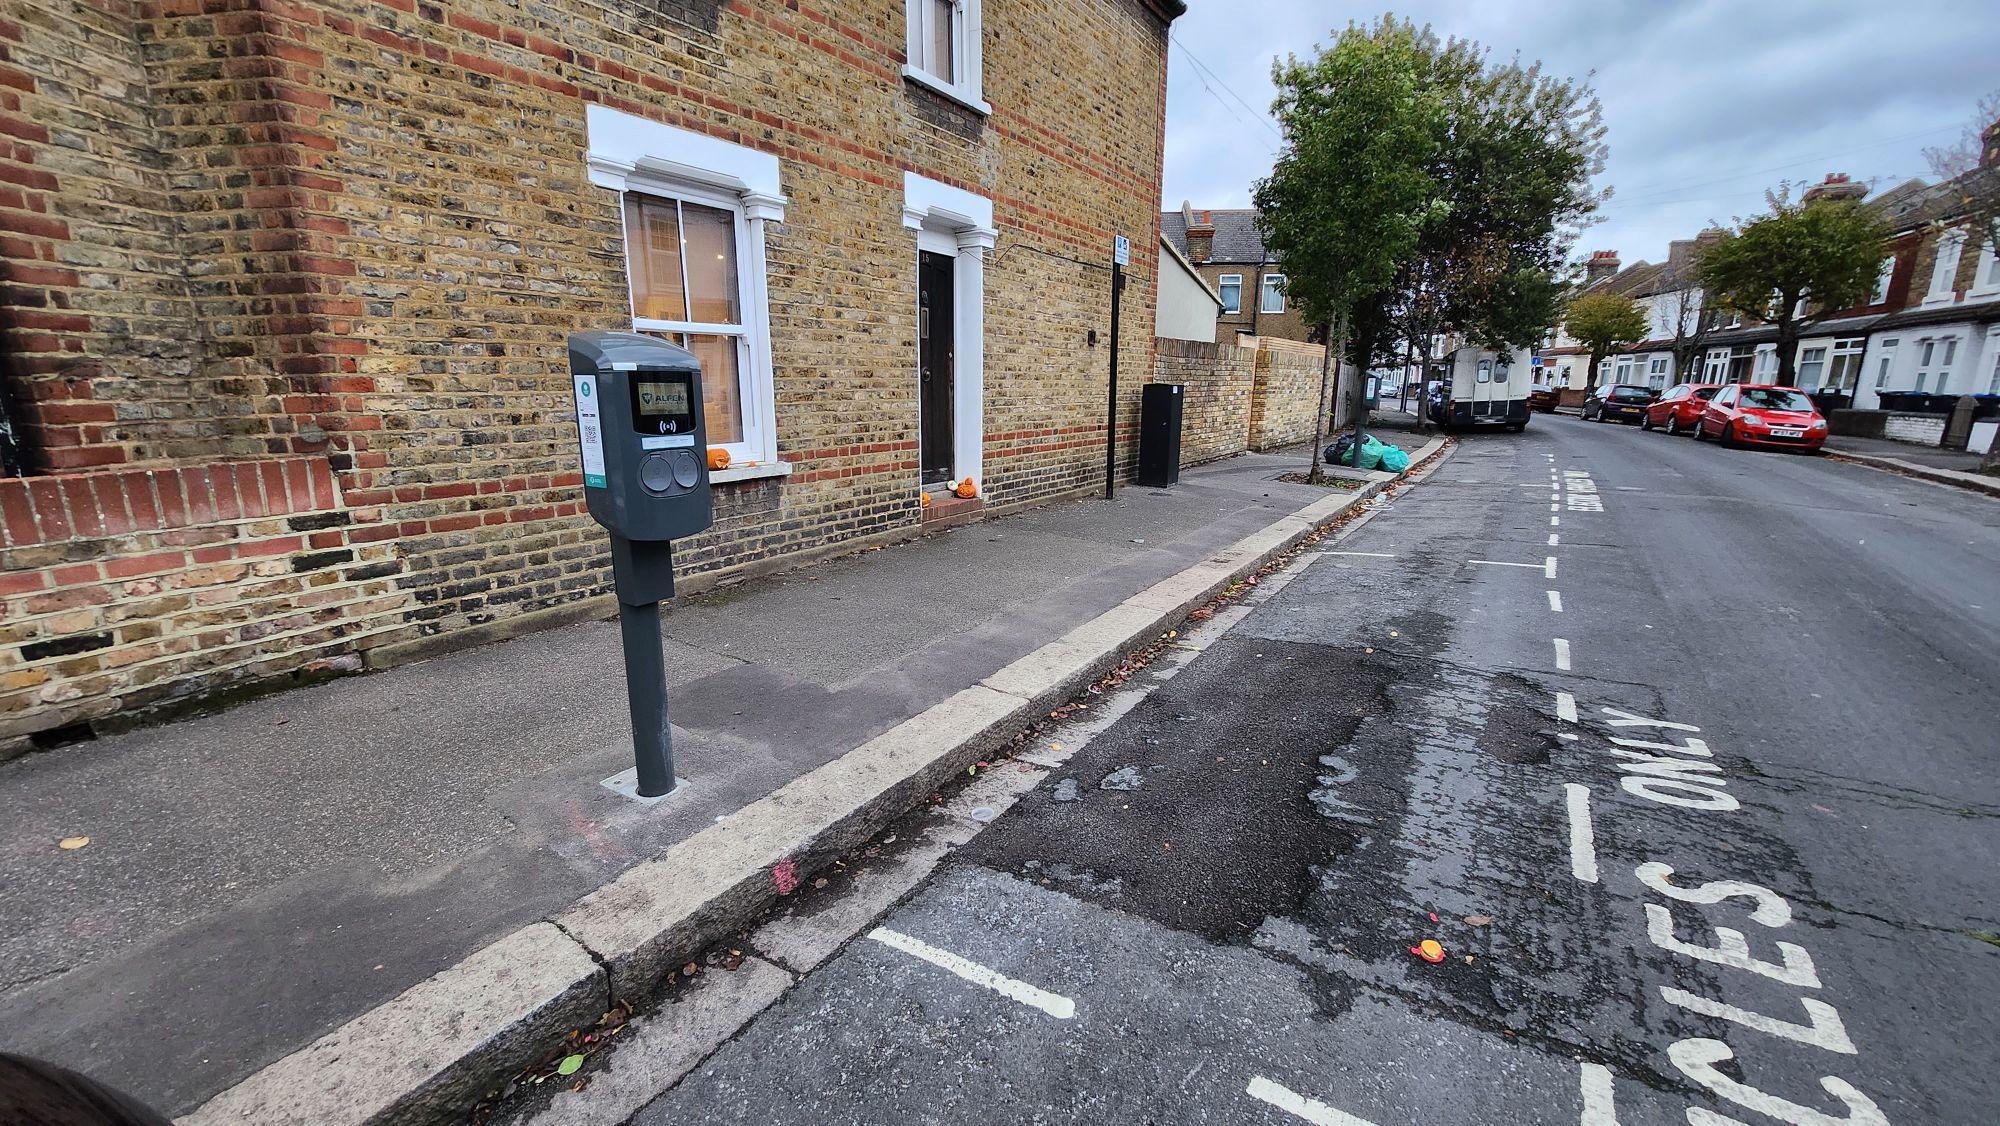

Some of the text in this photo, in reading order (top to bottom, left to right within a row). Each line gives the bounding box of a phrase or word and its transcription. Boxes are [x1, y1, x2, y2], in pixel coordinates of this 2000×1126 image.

[922, 253, 930, 263] 15
[1602, 707, 1891, 1126] CLES ONLY
